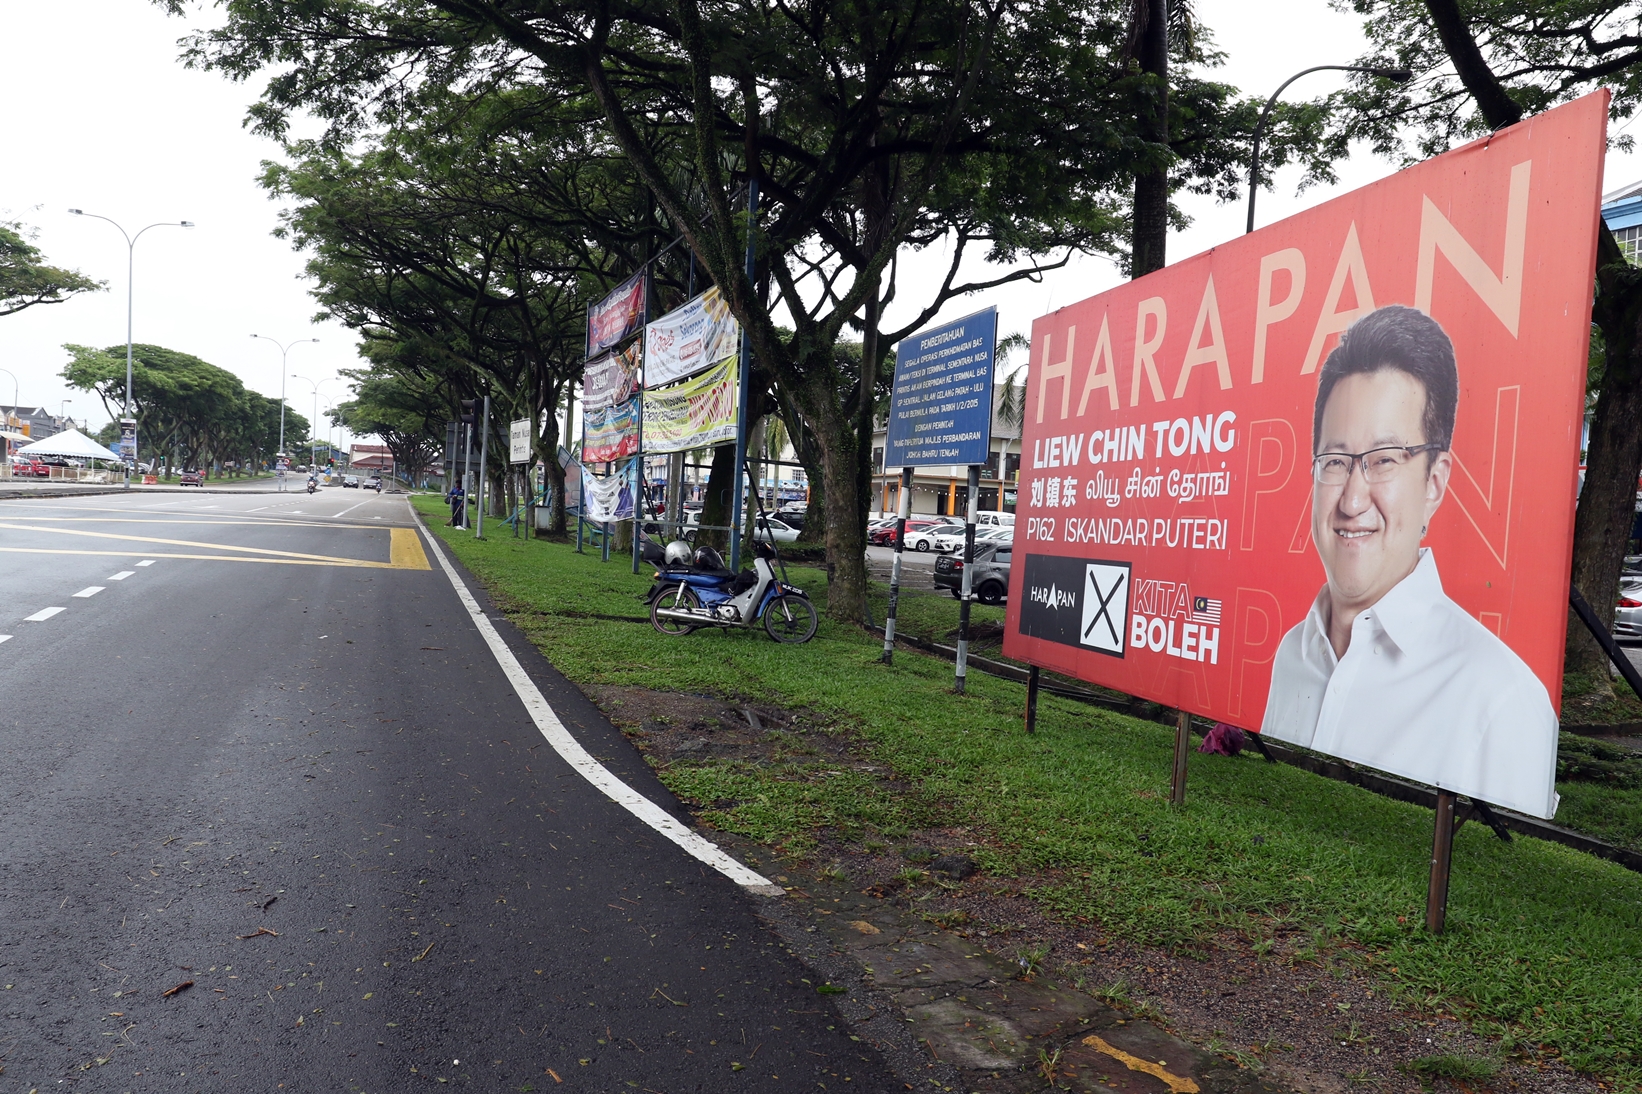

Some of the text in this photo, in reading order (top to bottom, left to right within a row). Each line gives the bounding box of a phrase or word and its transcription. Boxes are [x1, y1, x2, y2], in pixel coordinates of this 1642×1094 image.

[1036, 159, 1532, 424] HARAPAN
[904, 357, 920, 368] SEGALA
[972, 337, 983, 348] BAS
[920, 326, 965, 351] PEMBERITAHUAN
[947, 357, 973, 370] SEMENTARA
[974, 351, 988, 362] NUSA
[976, 366, 987, 376] BAS
[903, 395, 921, 406] SENTRAL
[921, 394, 936, 403] JALAN
[936, 389, 955, 400] GELANG
[973, 382, 984, 393] ULU
[898, 411, 909, 419] PULAI
[928, 405, 940, 415] PADA
[942, 431, 981, 443] PERBANDARAN
[1033, 410, 1237, 469] LIEW CHIN TONG
[1029, 475, 1078, 508] 刘镇东
[1086, 461, 1230, 508] லியூ சின் தோங்
[1027, 517, 1228, 550] P162 ISKANDAR PUTERI
[1133, 578, 1192, 621] KITA
[1130, 614, 1220, 665] BOLEH
